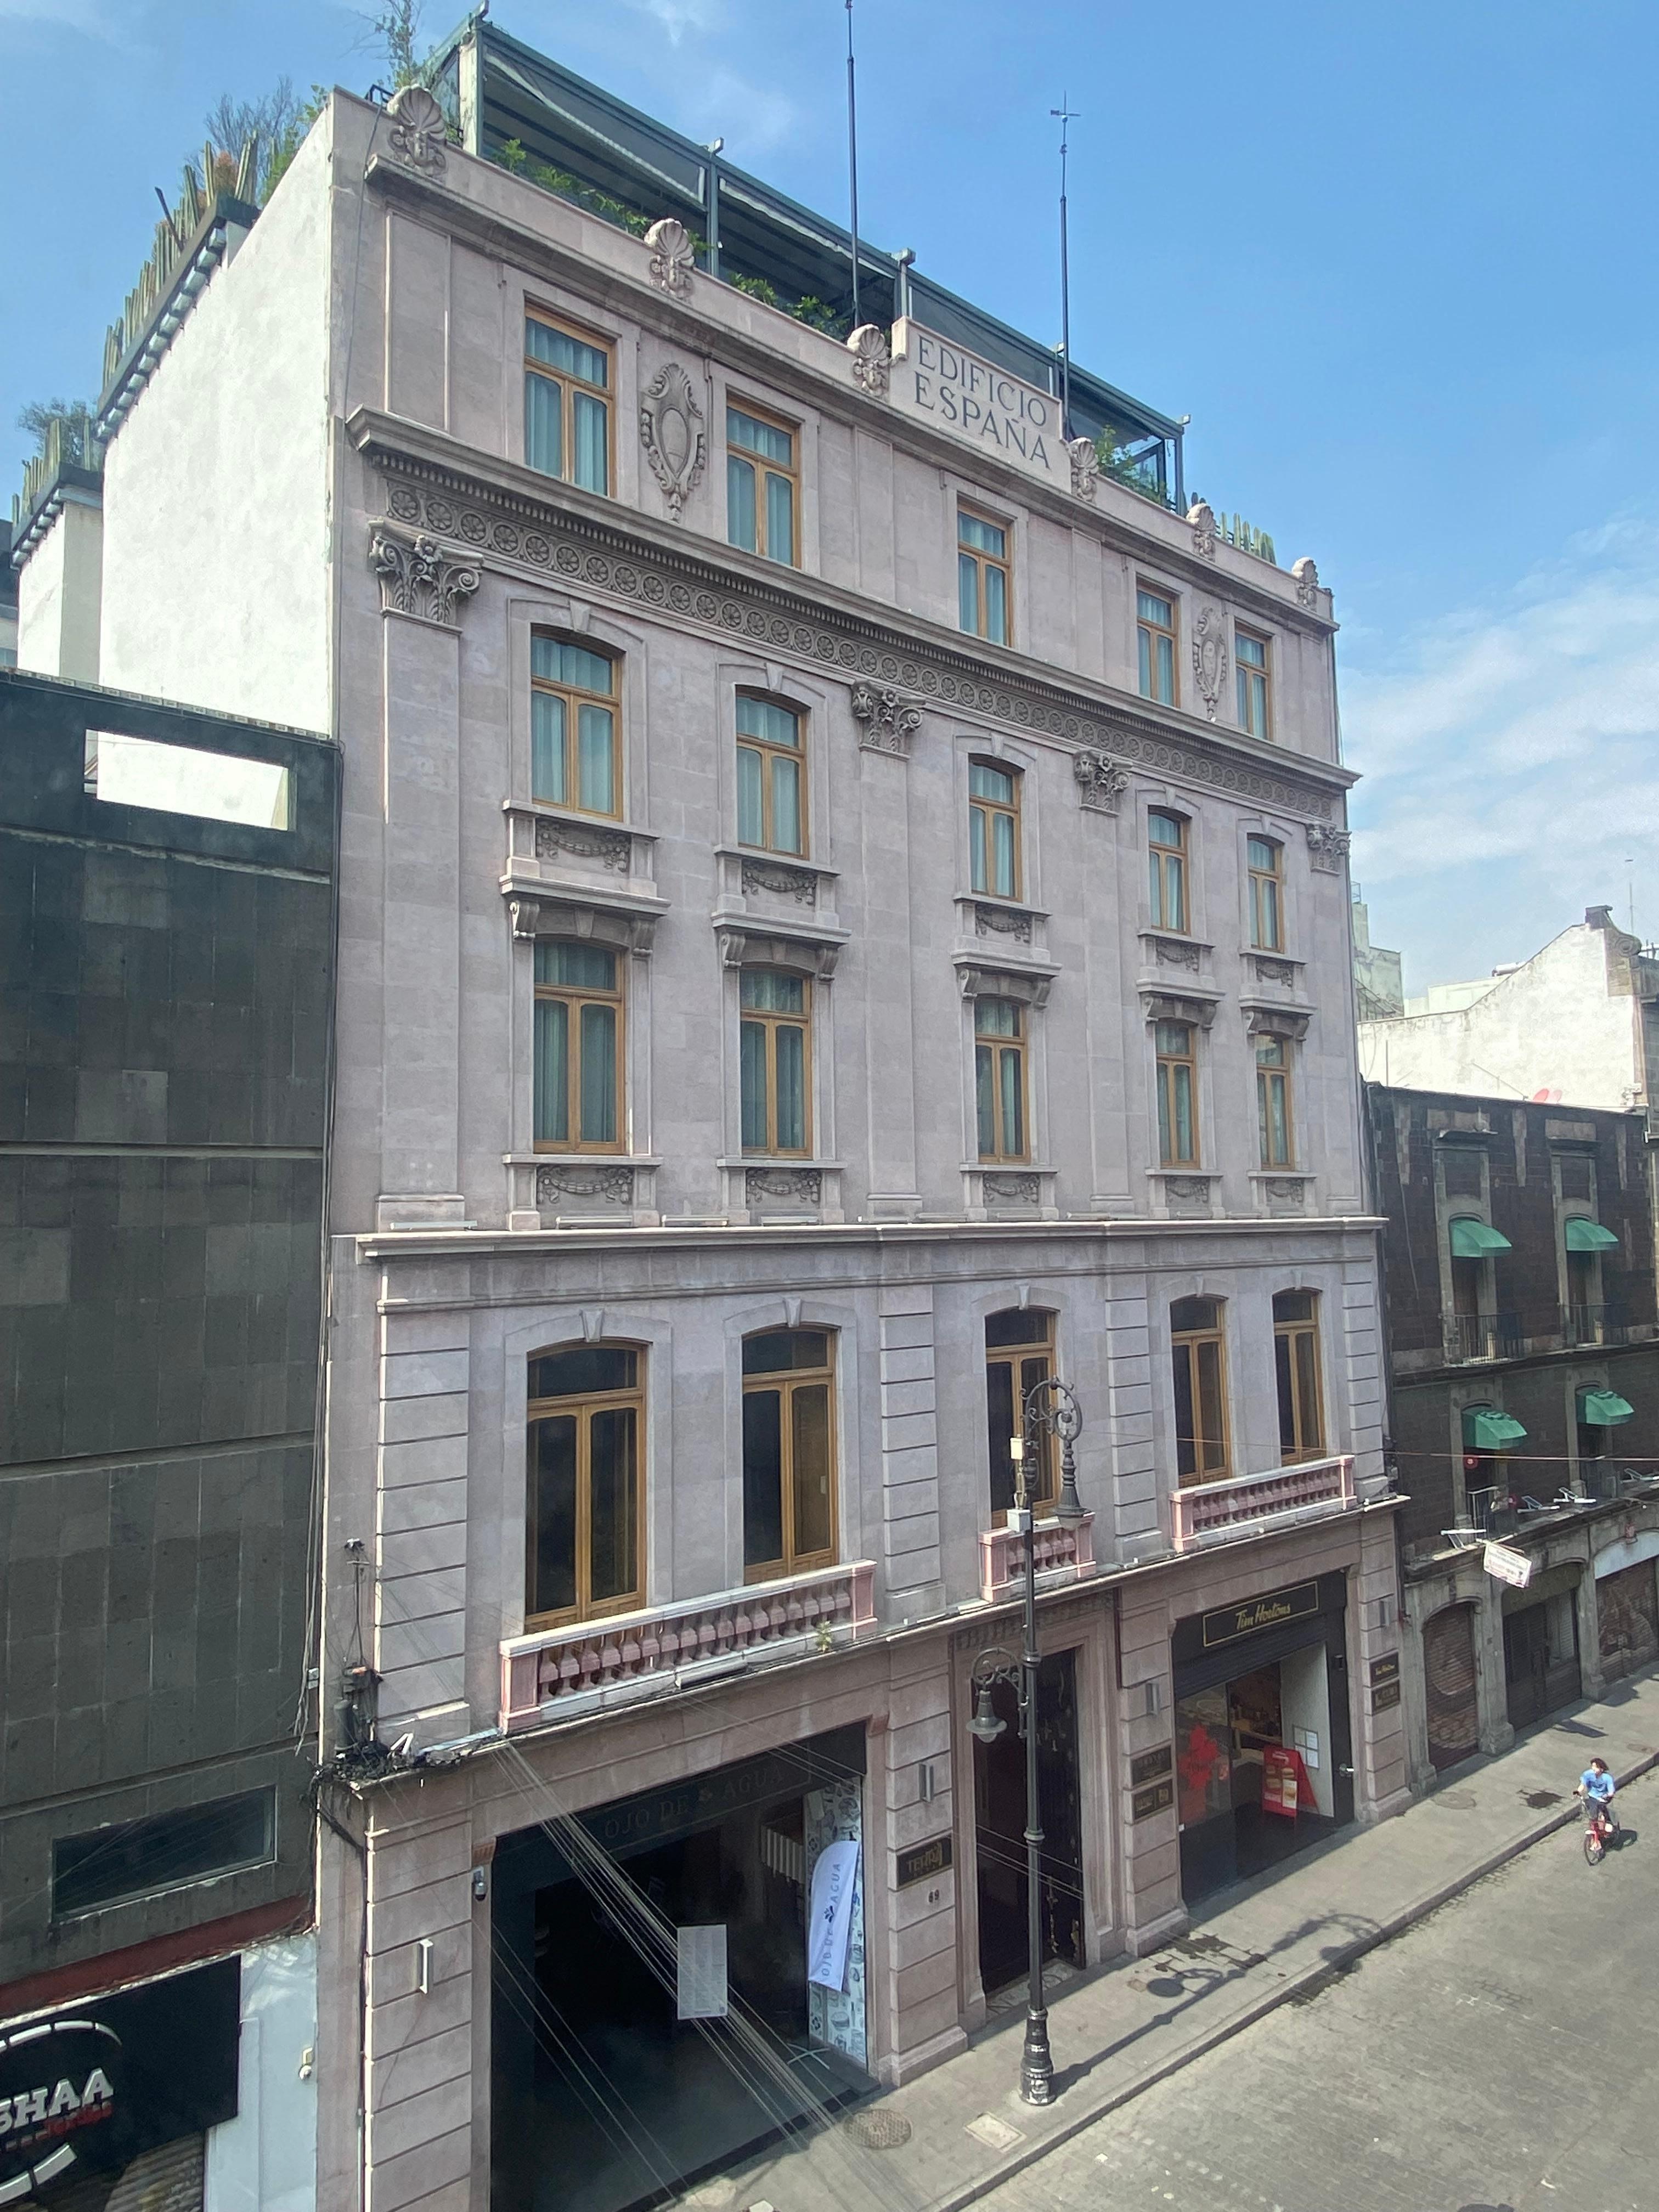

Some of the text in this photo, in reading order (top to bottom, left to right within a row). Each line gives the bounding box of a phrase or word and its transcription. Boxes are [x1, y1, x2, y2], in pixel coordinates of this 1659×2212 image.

[917, 334, 1047, 426] EDIFICIO
[914, 371, 1051, 470] ESPAÑA
[1235, 1603, 1291, 1630] Tim Hortons
[605, 1765, 784, 1839] OJO DE AGUA
[830, 1864, 840, 1904] AGUA
